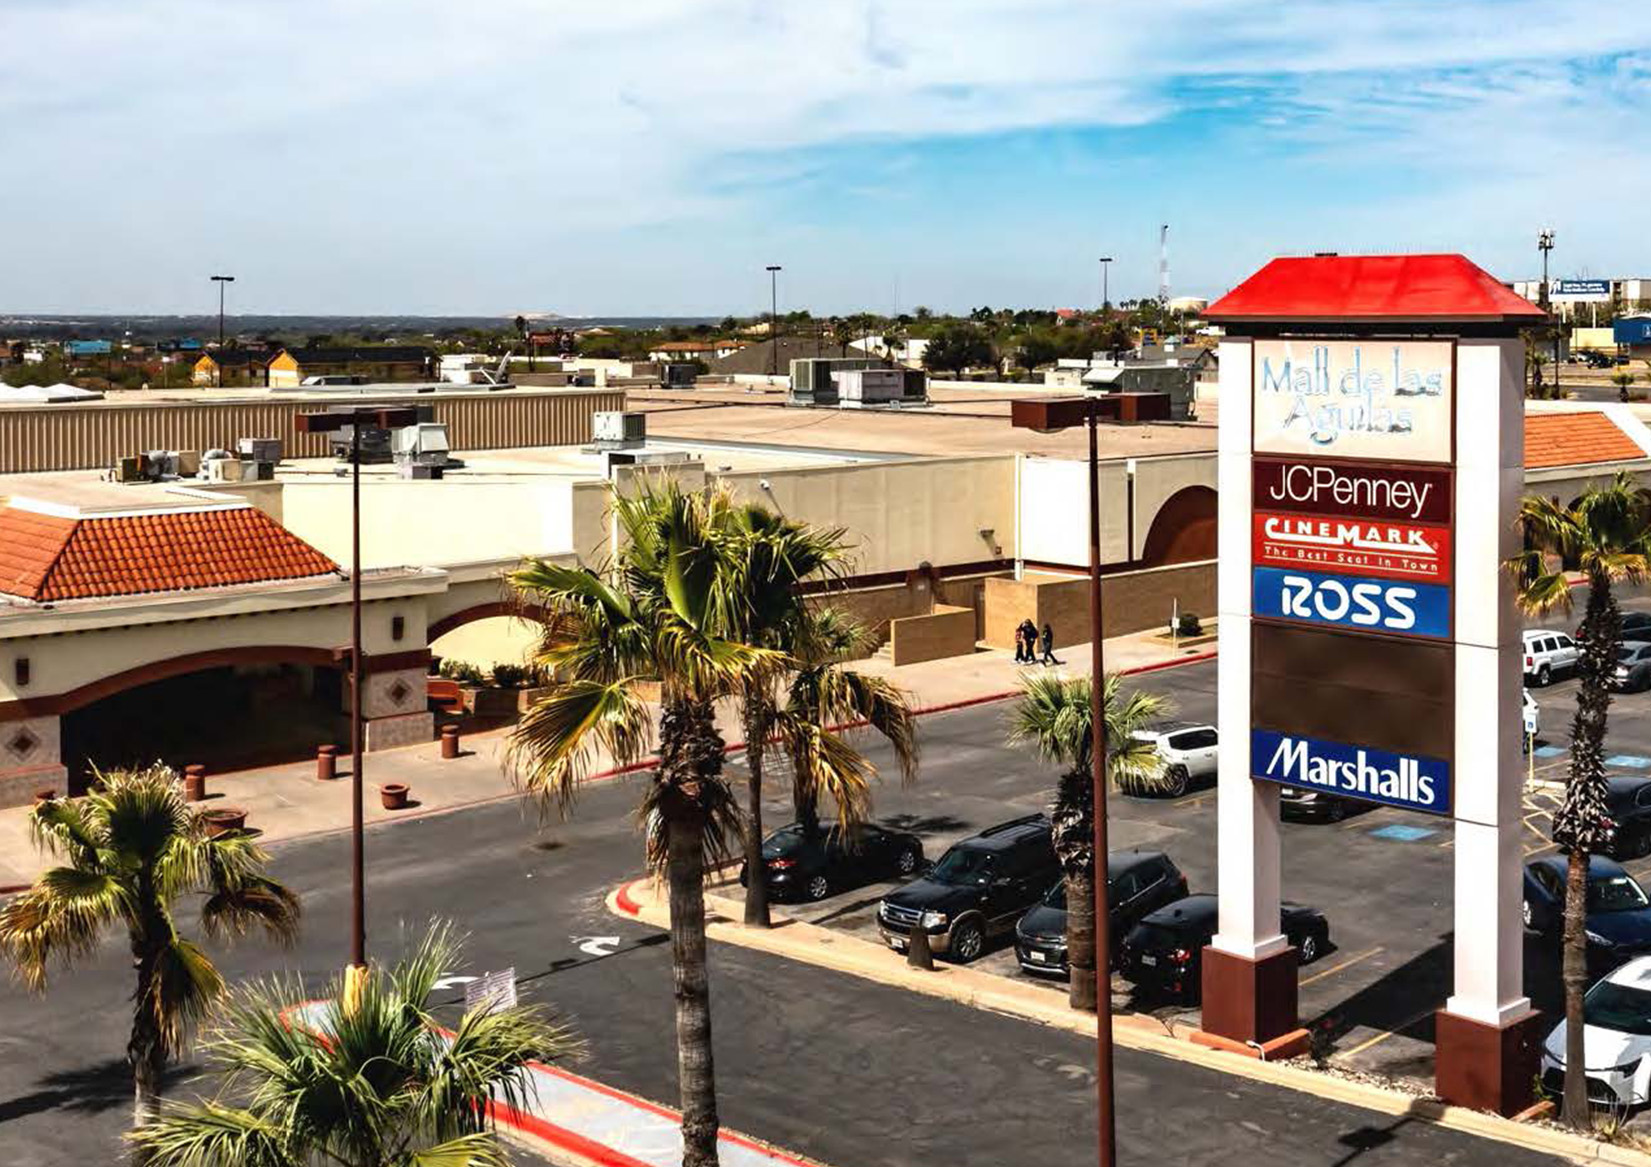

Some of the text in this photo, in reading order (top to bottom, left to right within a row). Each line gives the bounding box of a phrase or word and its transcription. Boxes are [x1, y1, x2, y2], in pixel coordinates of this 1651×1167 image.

[1262, 346, 1442, 396] Mall de las
[1270, 465, 1430, 518] JCPenney
[1264, 546, 1288, 556] The
[1298, 549, 1328, 560] Best
[1337, 553, 1369, 565] Seat
[1402, 559, 1438, 571] Town
[1282, 575, 1417, 629] ROSS
[1266, 738, 1436, 805] Marshalls
